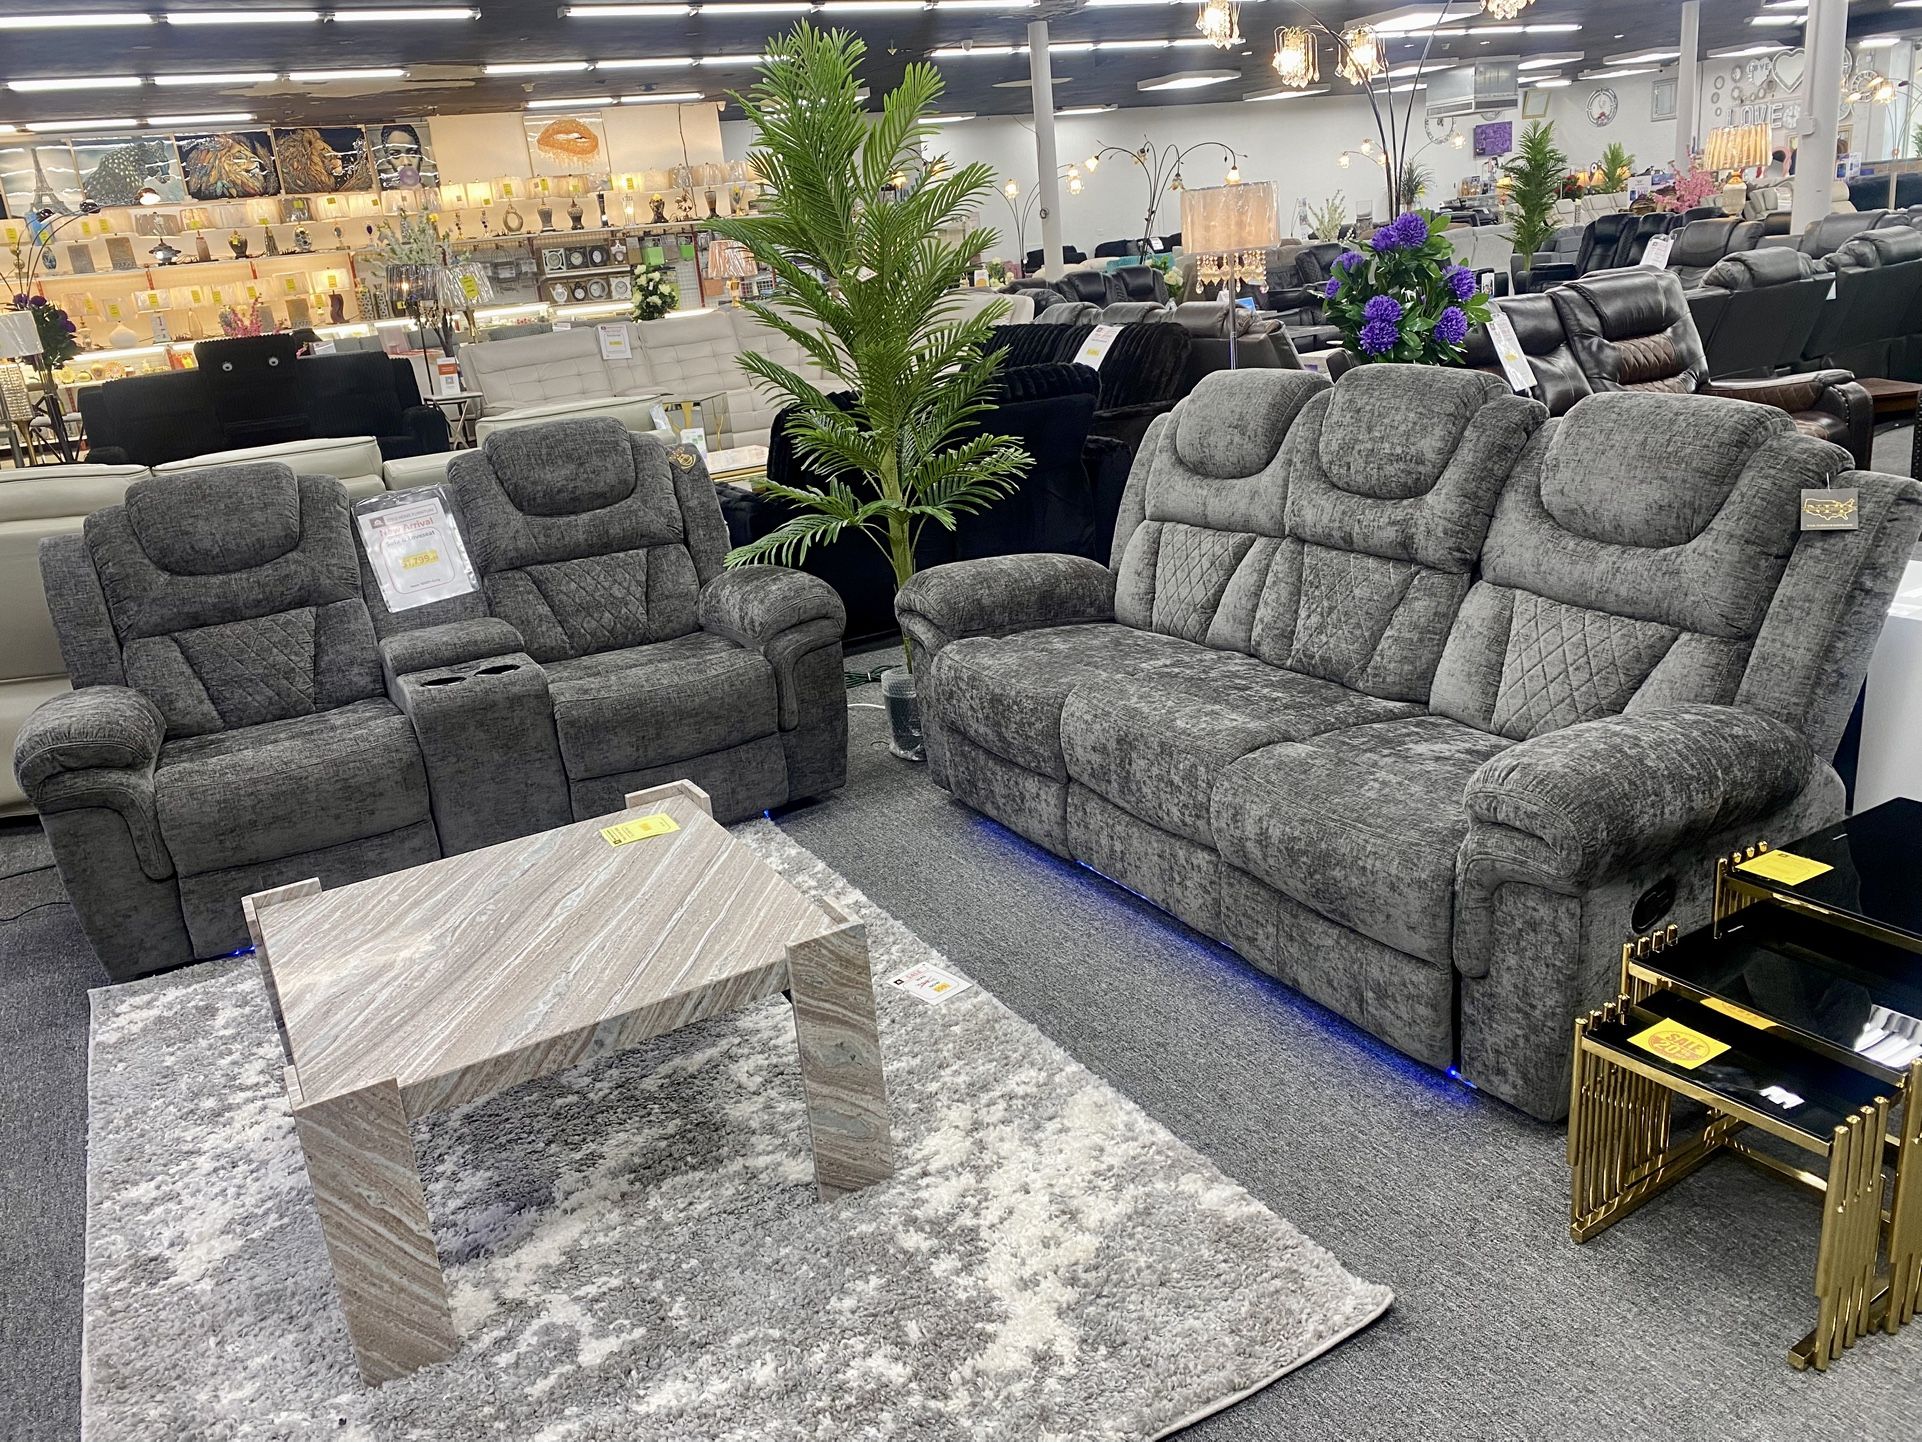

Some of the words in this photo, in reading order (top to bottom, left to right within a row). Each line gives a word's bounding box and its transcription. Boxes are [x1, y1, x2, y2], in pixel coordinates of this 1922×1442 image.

[1748, 62, 1770, 73] LOVE
[1727, 103, 1783, 128] LOVE
[403, 517, 434, 531] Arrival
[1666, 1033, 1704, 1051] SALE
